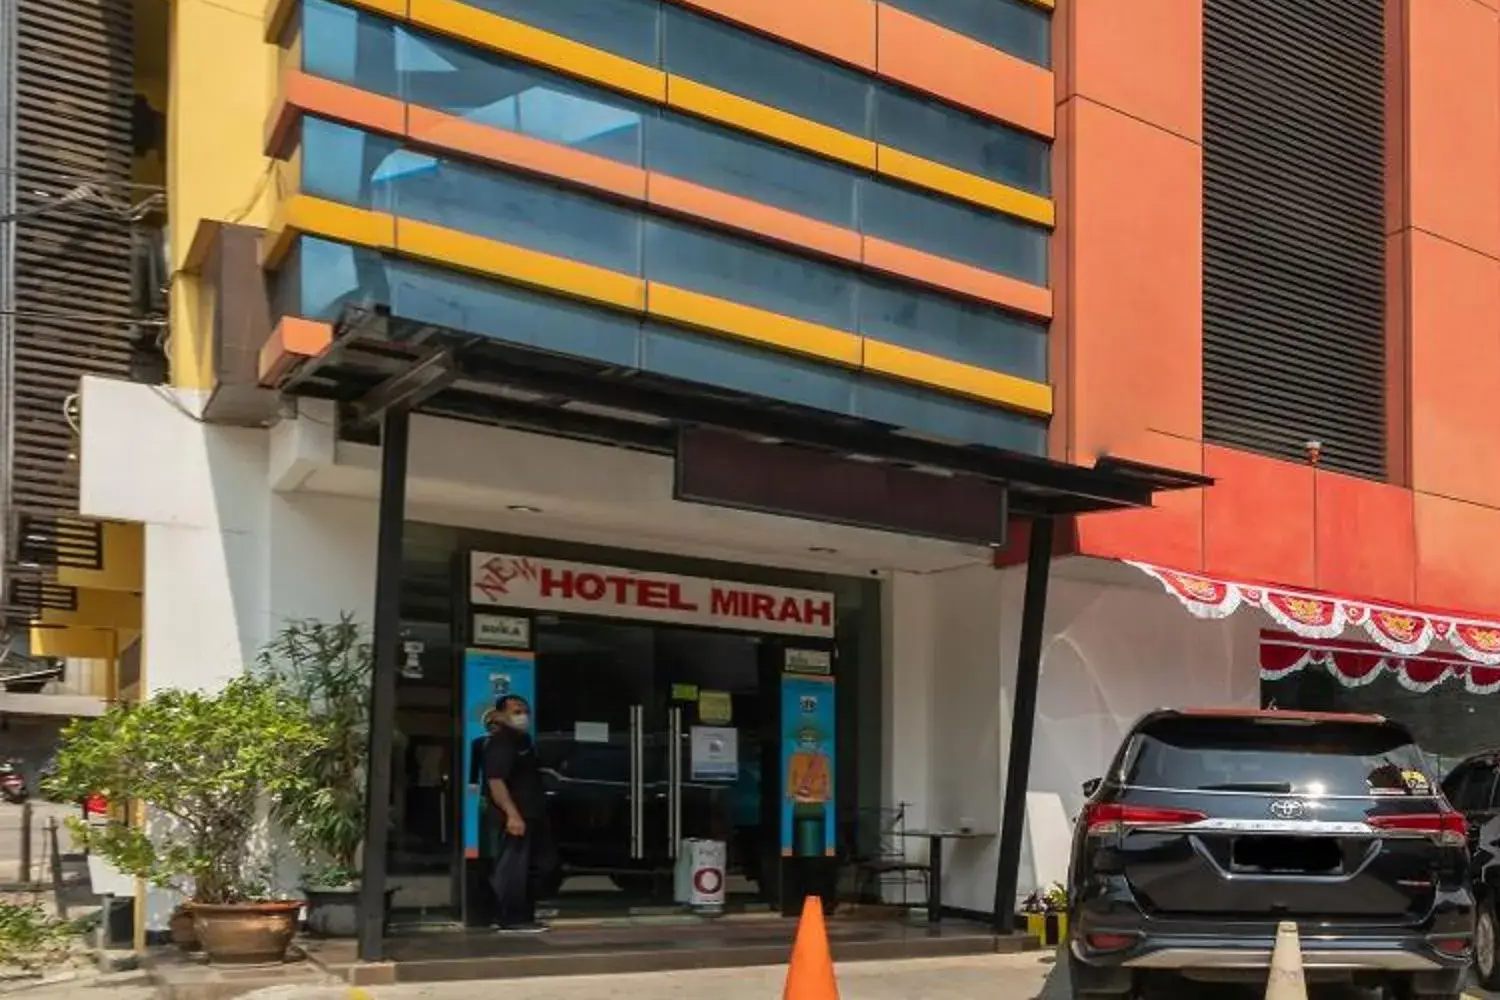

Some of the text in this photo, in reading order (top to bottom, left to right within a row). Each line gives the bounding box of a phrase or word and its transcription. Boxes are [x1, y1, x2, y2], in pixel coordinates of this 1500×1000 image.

[474, 557, 831, 627] NEW HOTEL MIRAH
